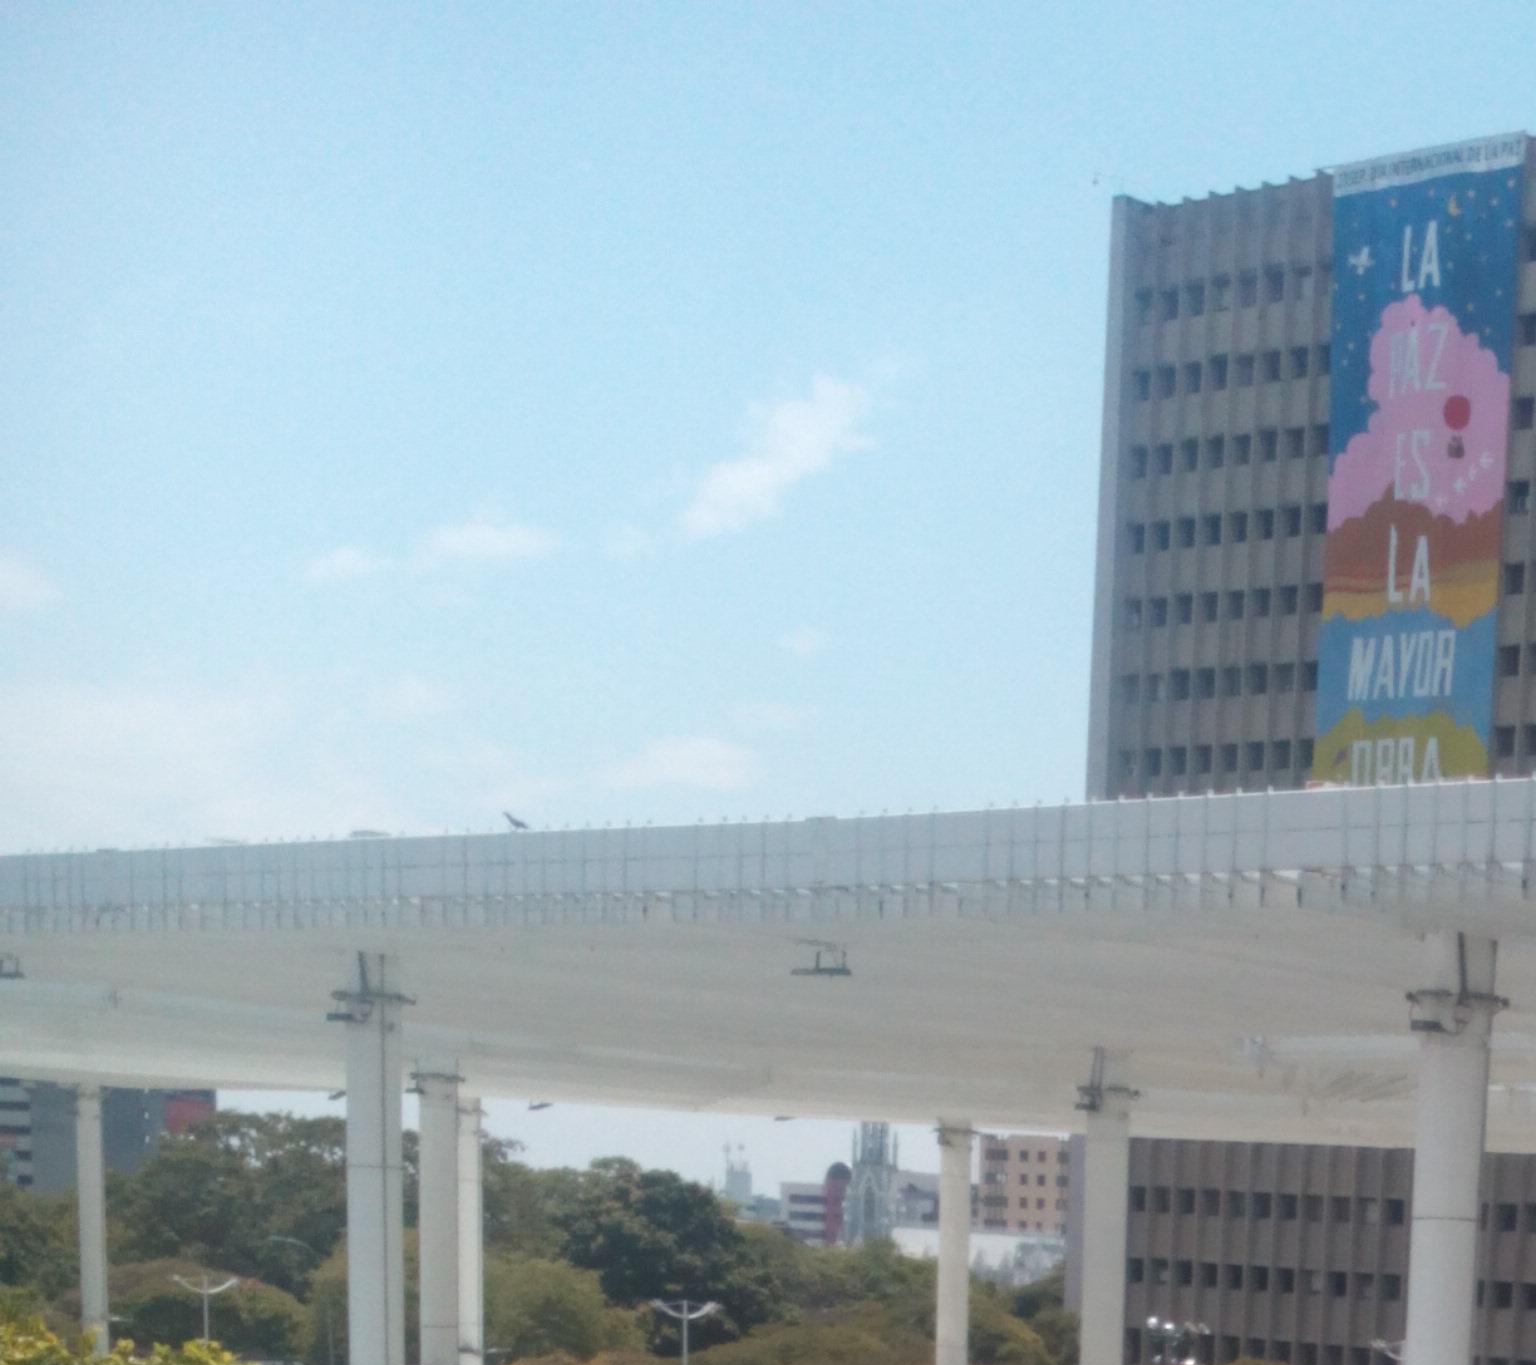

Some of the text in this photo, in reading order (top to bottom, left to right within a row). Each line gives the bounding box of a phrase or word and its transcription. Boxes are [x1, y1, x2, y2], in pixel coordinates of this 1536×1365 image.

[1402, 220, 1441, 292] LA
[1389, 321, 1449, 399] PAZ
[1394, 429, 1430, 500] ES
[1387, 523, 1431, 603] LA
[1348, 629, 1456, 701] MAYOR
